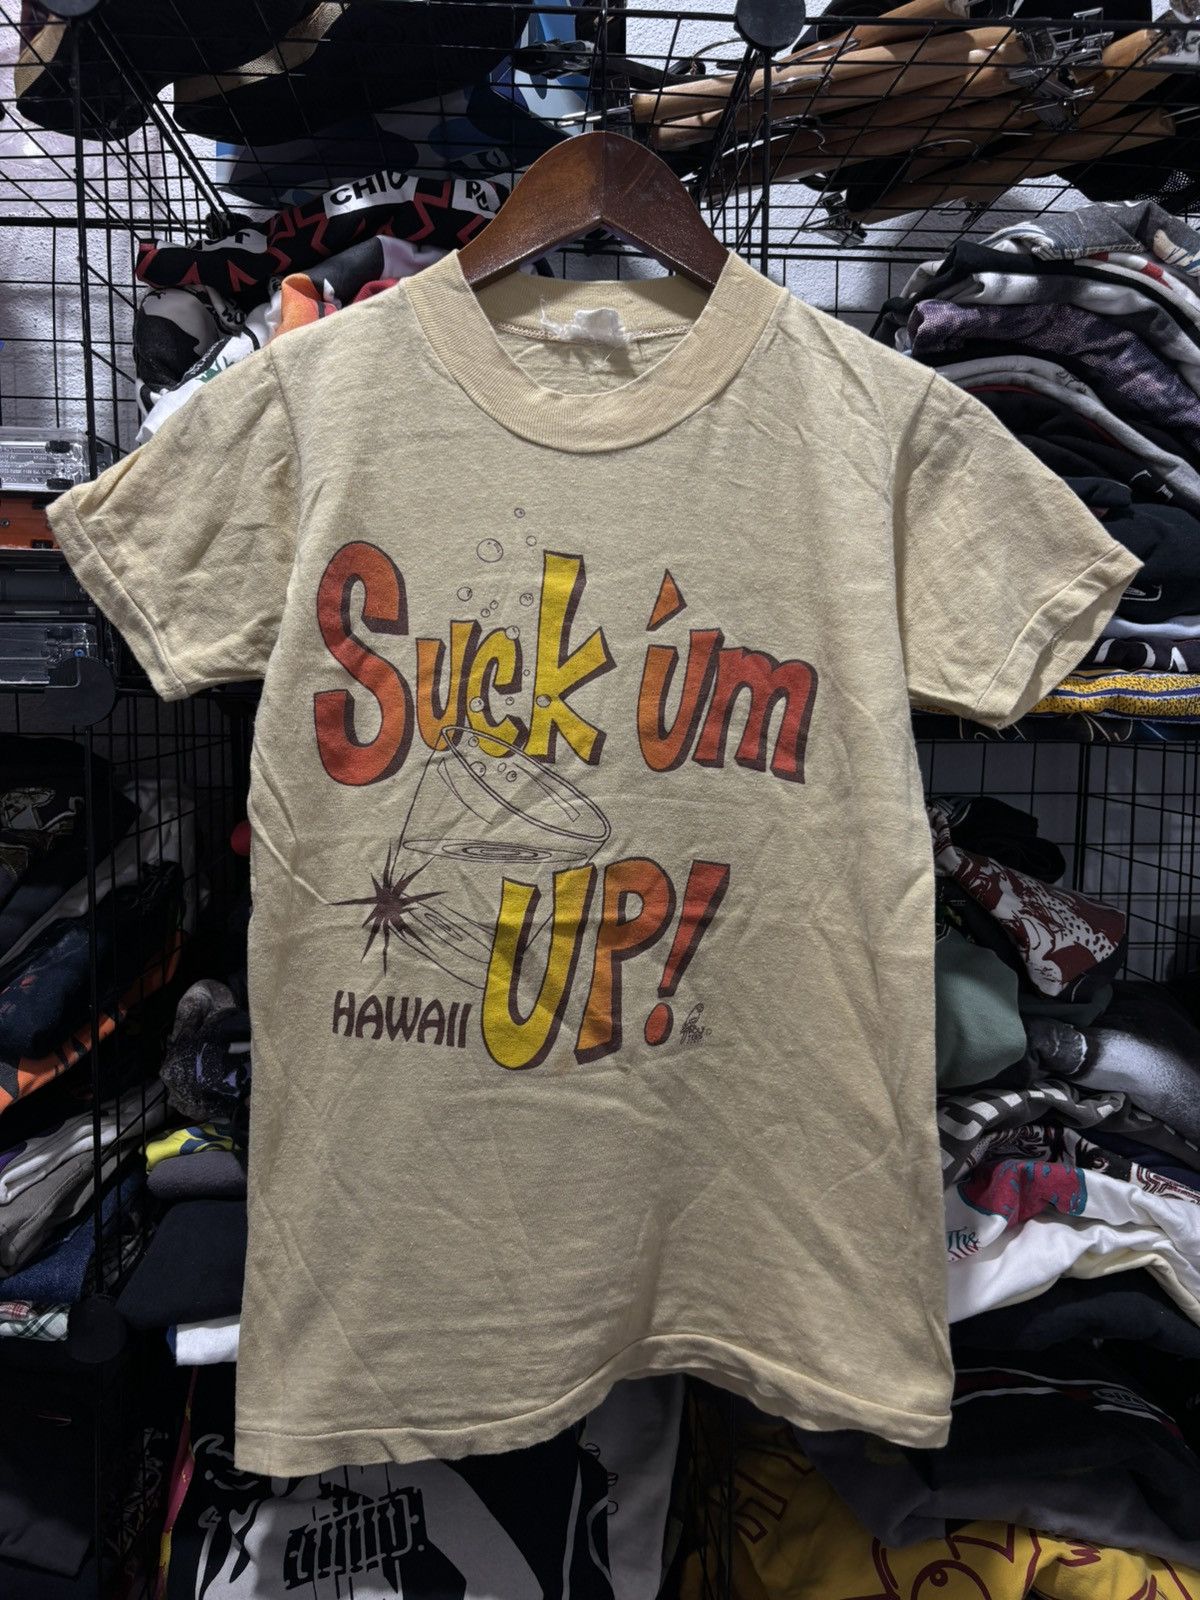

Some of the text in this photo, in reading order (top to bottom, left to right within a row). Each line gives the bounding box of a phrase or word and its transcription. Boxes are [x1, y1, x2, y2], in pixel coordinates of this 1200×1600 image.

[313, 541, 618, 786] Suck
[332, 990, 473, 1049] HAWAII
[480, 857, 731, 1071] UP!
